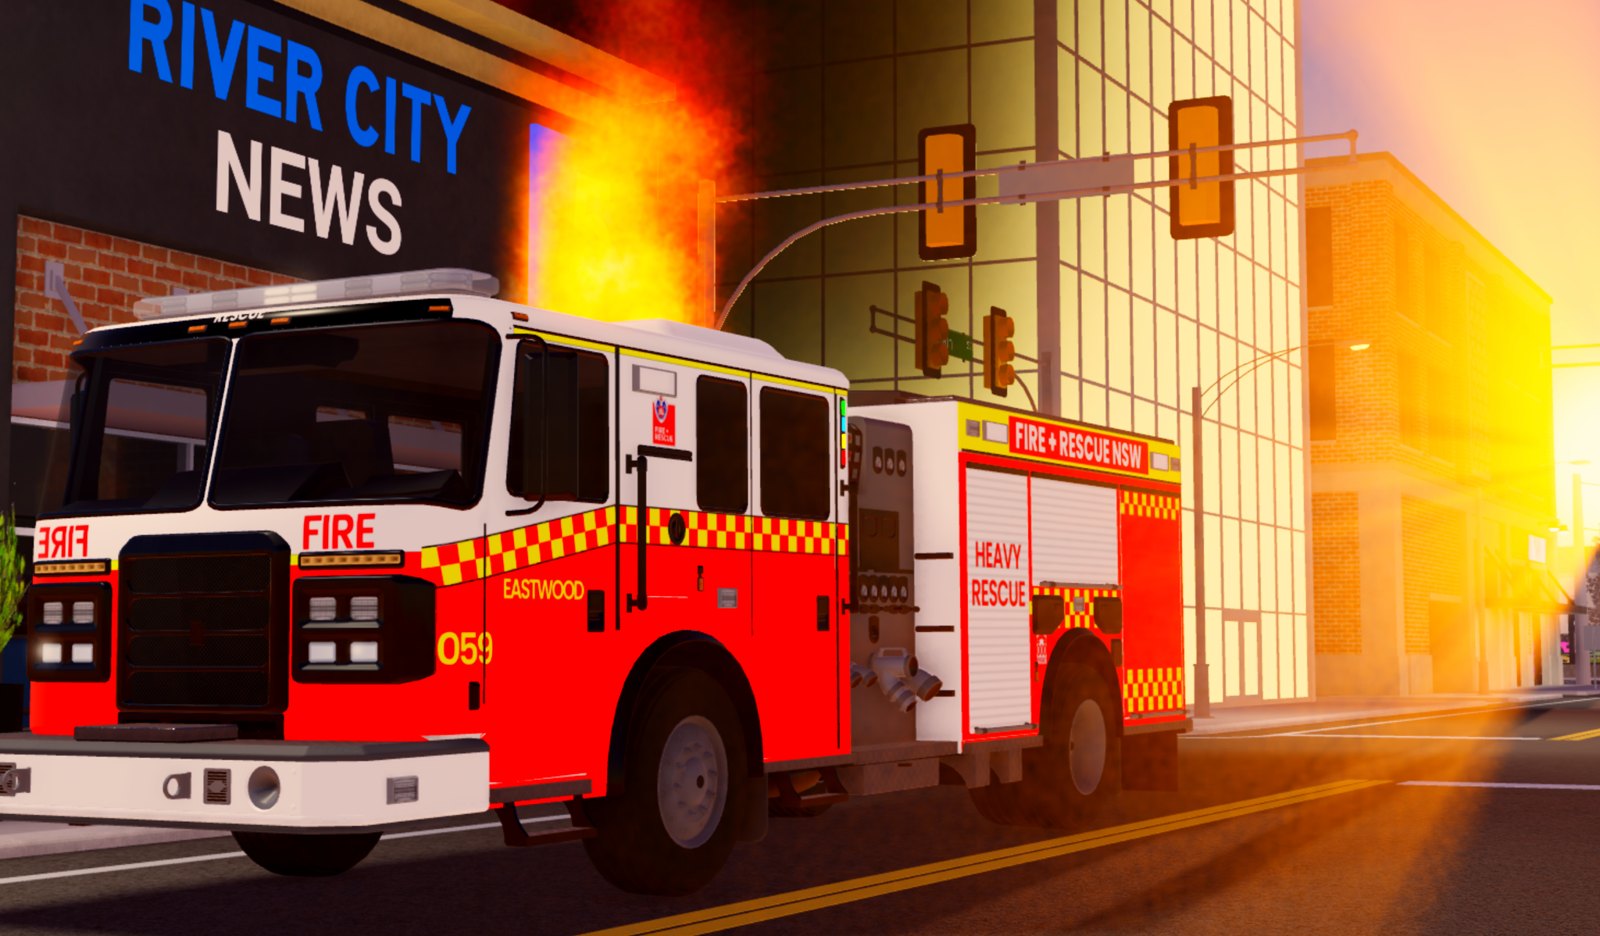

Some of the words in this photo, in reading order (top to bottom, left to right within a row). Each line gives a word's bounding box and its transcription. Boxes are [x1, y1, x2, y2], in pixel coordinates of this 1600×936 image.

[128, 0, 323, 131] RIVER
[345, 65, 471, 175] CITY
[215, 129, 403, 256] NEWS
[1015, 422, 1046, 453] FIRE
[1059, 430, 1110, 464] RESCUE
[1112, 440, 1142, 469] NSW
[302, 512, 376, 551] FIRE
[975, 541, 1022, 570] HEAVY
[503, 578, 585, 600] EASTWOOD
[971, 579, 1026, 607] RESCUE
